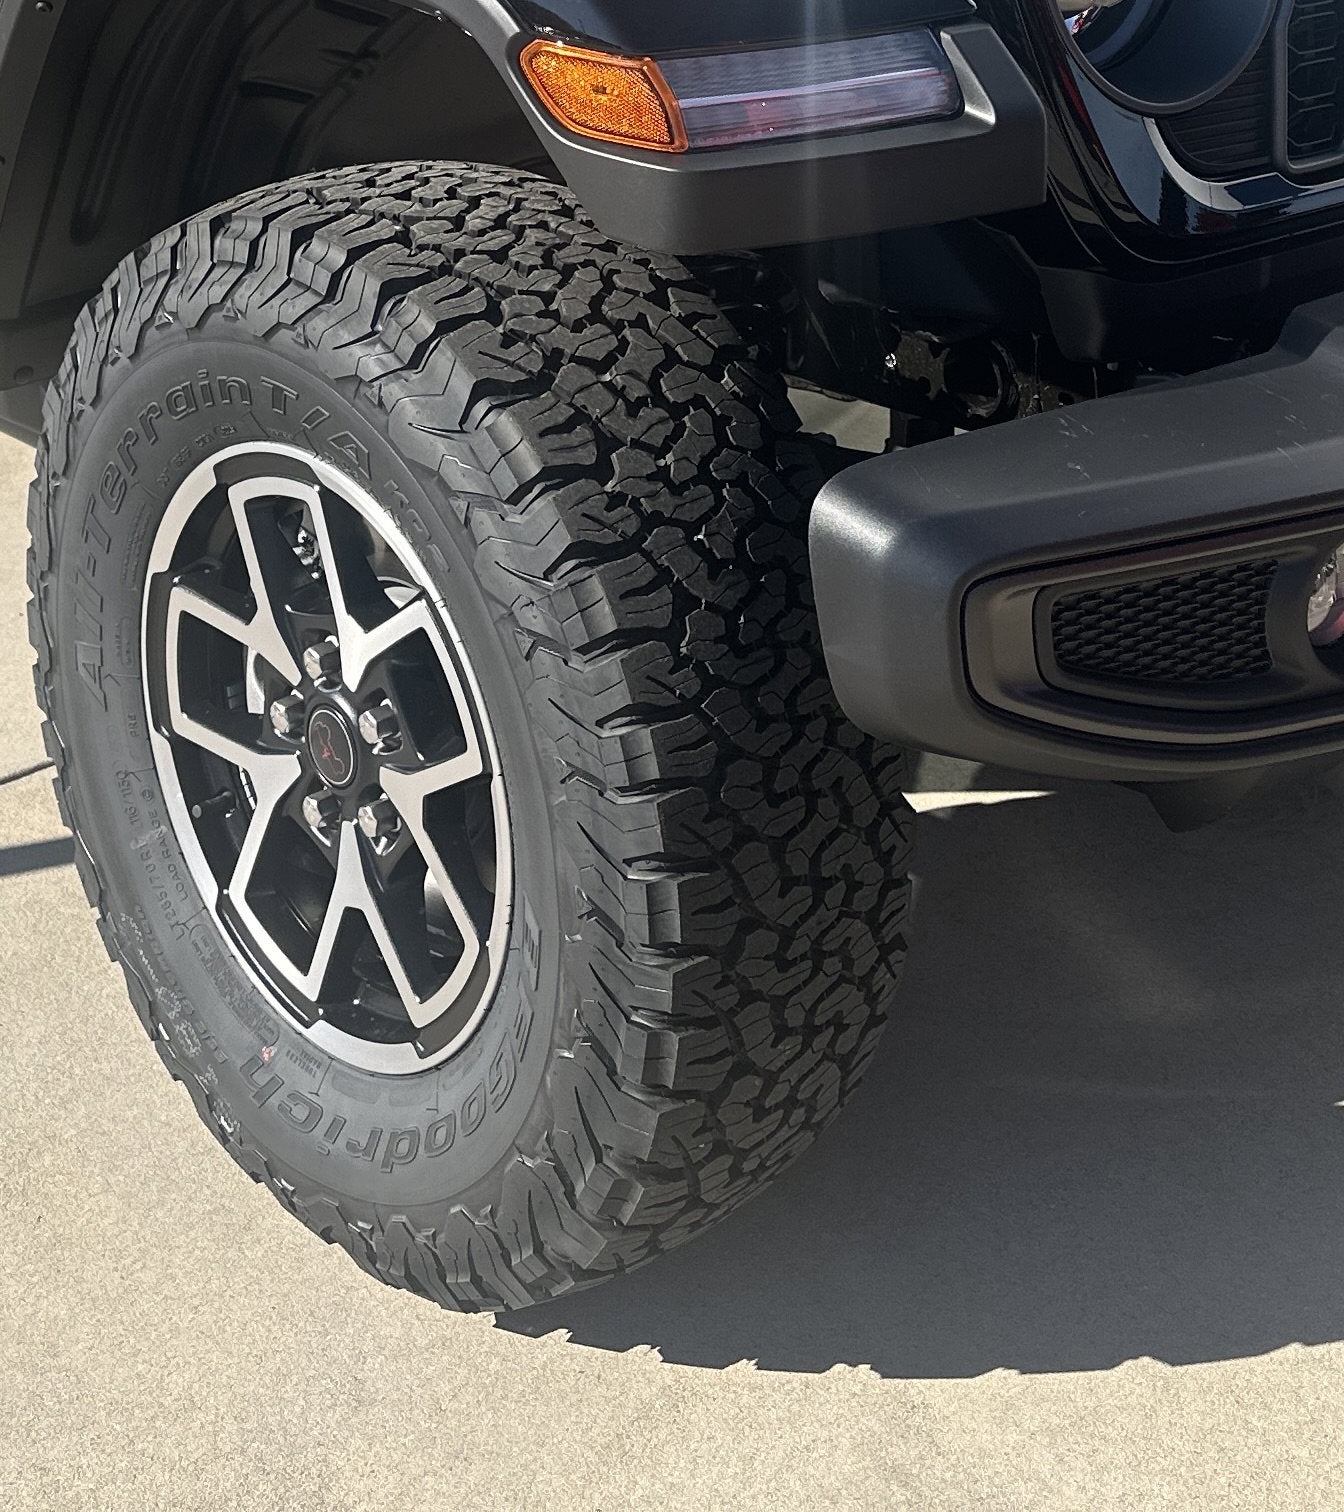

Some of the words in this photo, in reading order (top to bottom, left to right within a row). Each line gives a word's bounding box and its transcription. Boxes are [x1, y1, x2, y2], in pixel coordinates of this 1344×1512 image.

[75, 369, 252, 713] All-Terrain
[260, 376, 372, 481] T/A
[148, 811, 173, 859] RANGE
[167, 863, 188, 902] LOAD
[239, 890, 542, 1174] BFGoodrich
